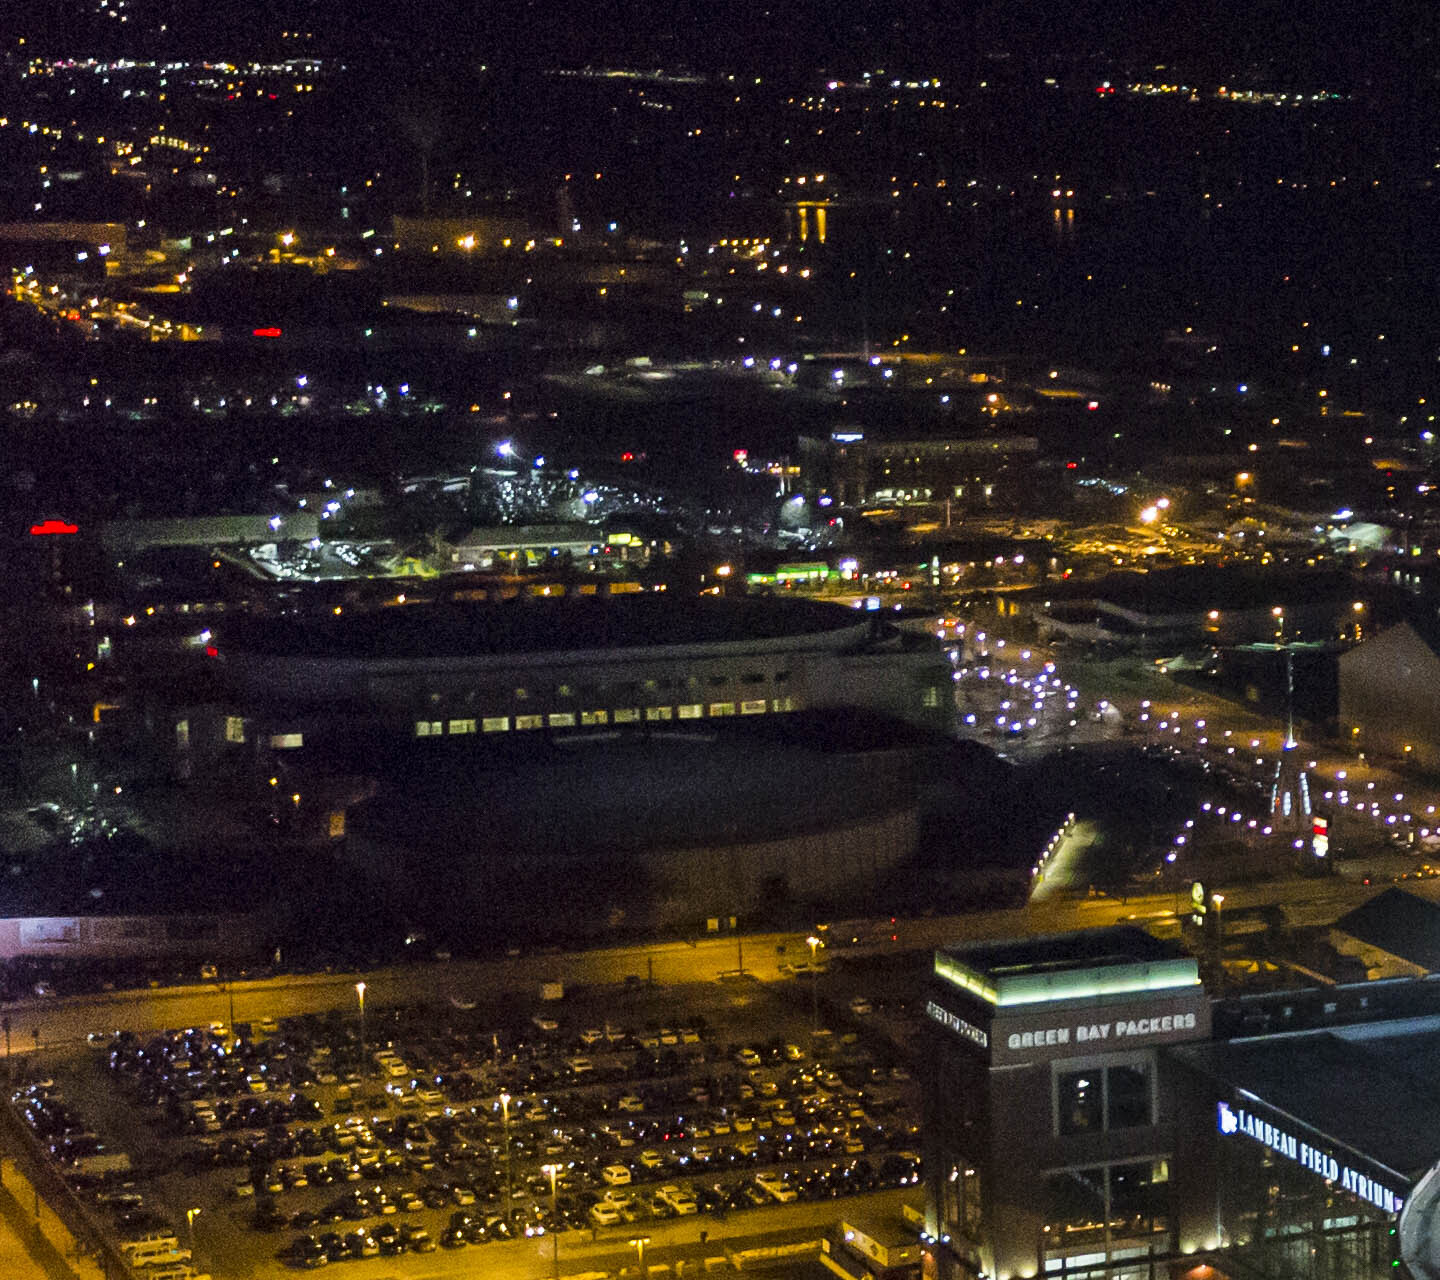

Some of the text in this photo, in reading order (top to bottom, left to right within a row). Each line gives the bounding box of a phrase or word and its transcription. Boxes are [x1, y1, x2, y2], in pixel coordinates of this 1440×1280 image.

[1008, 1013, 1197, 1049] GREEN BAY PACKERS
[1239, 1109, 1395, 1213] LAMBEAU FIELD ATRIUM
